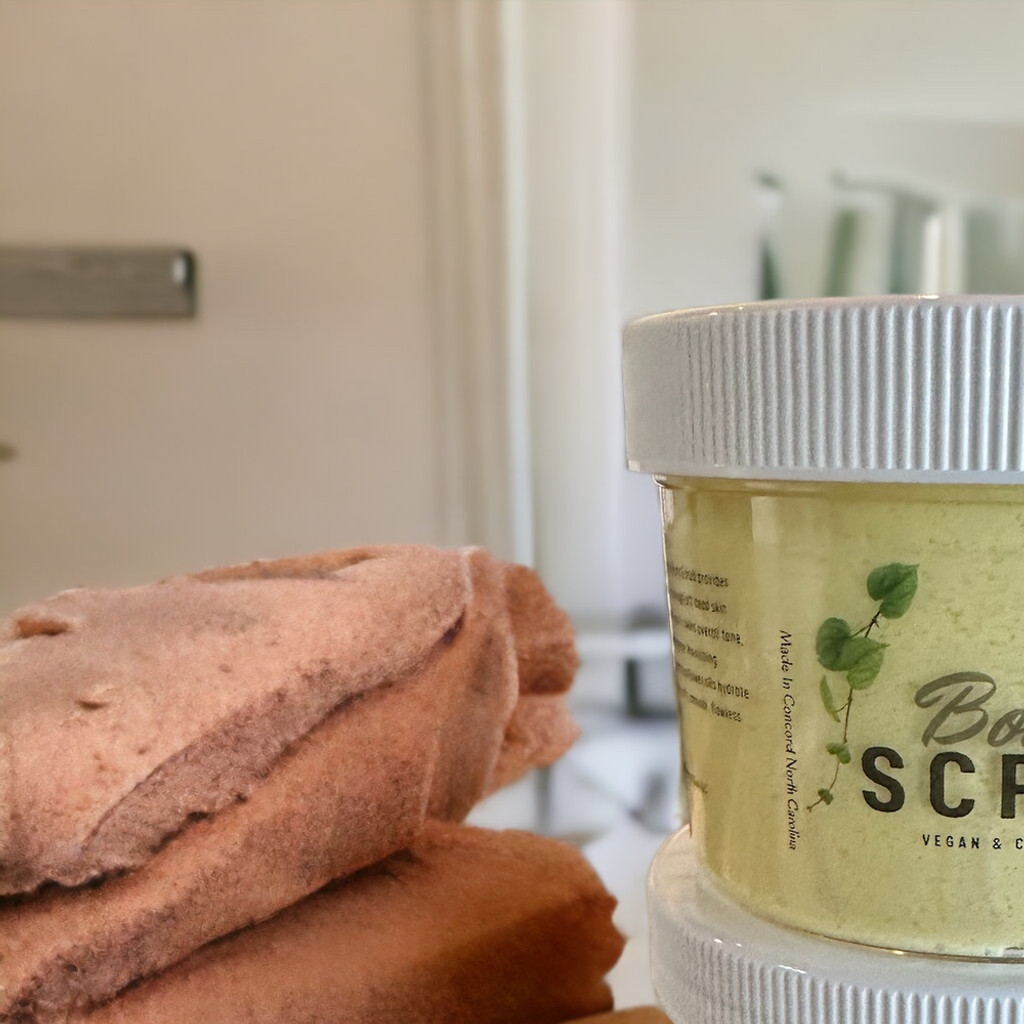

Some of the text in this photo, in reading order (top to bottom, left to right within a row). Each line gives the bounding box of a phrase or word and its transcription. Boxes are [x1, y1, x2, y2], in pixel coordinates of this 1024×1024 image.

[779, 629, 800, 850] Made In Concord North Carolina
[922, 833, 981, 850] VEGAN
[992, 838, 1003, 850] &
